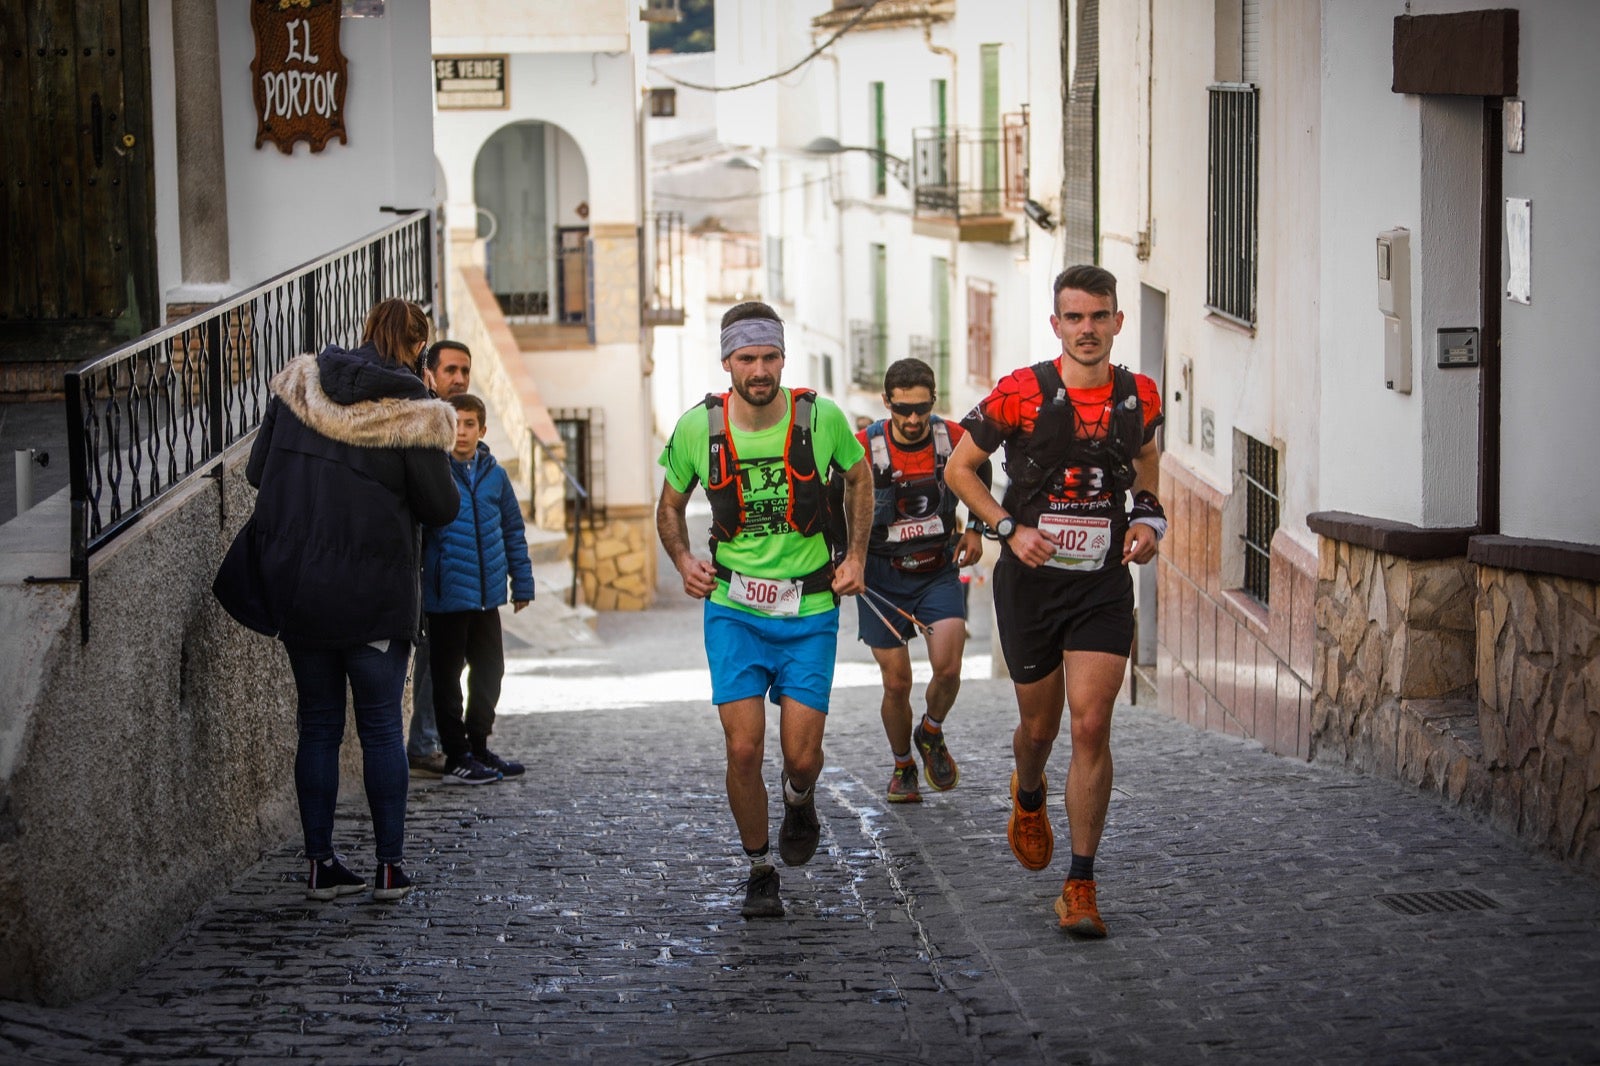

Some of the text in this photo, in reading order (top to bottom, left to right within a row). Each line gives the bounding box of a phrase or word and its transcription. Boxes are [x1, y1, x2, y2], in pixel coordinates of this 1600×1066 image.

[285, 18, 319, 64] EL
[437, 60, 502, 79] SE VENDE
[262, 70, 338, 122] PORTON
[900, 524, 925, 541] 468
[1055, 529, 1088, 552] 402
[746, 580, 778, 604] 506
